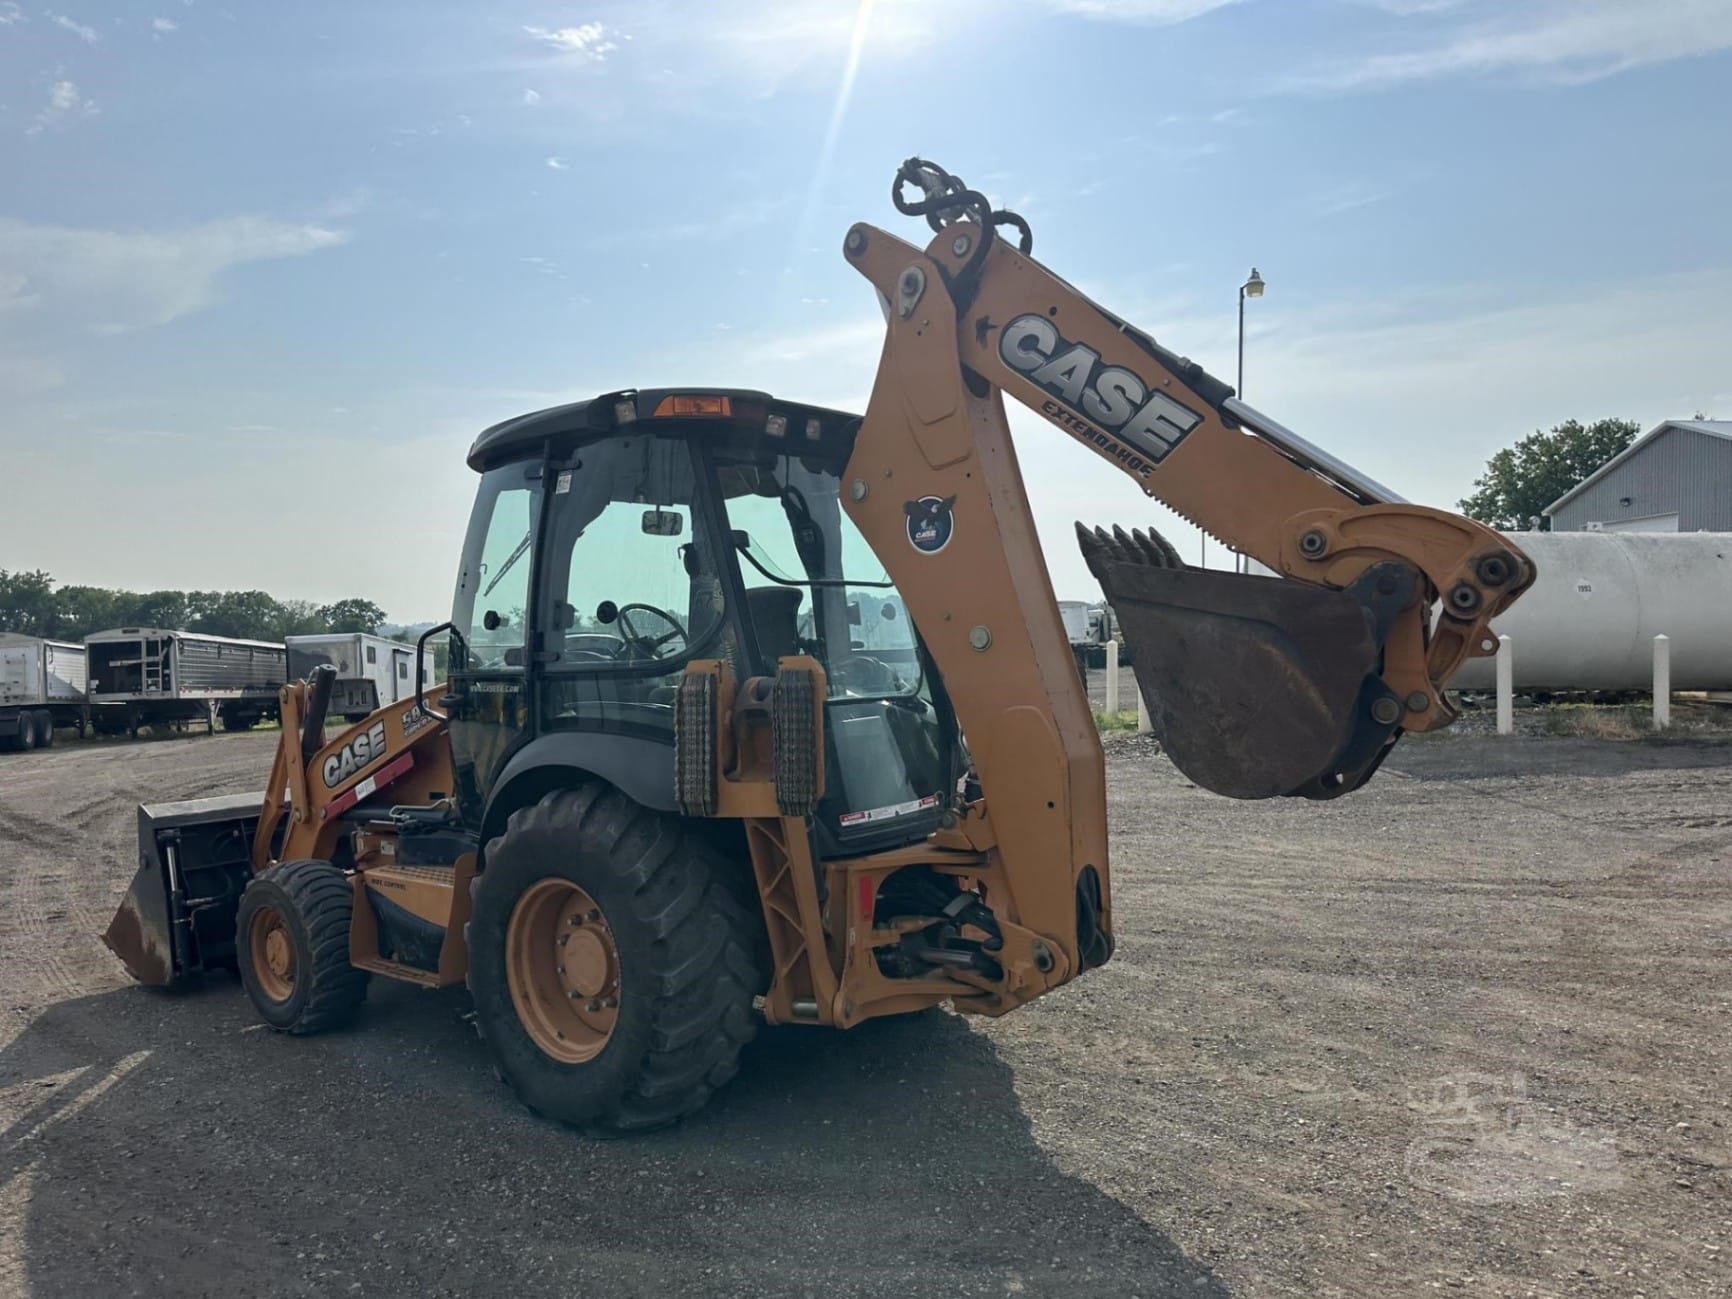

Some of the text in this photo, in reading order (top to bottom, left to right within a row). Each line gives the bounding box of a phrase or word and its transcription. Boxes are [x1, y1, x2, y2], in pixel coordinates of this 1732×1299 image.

[1000, 313, 1203, 462] CASE
[1042, 401, 1155, 478] EXTENDAHOE
[915, 530, 937, 538] CASE
[323, 720, 386, 788] CASE
